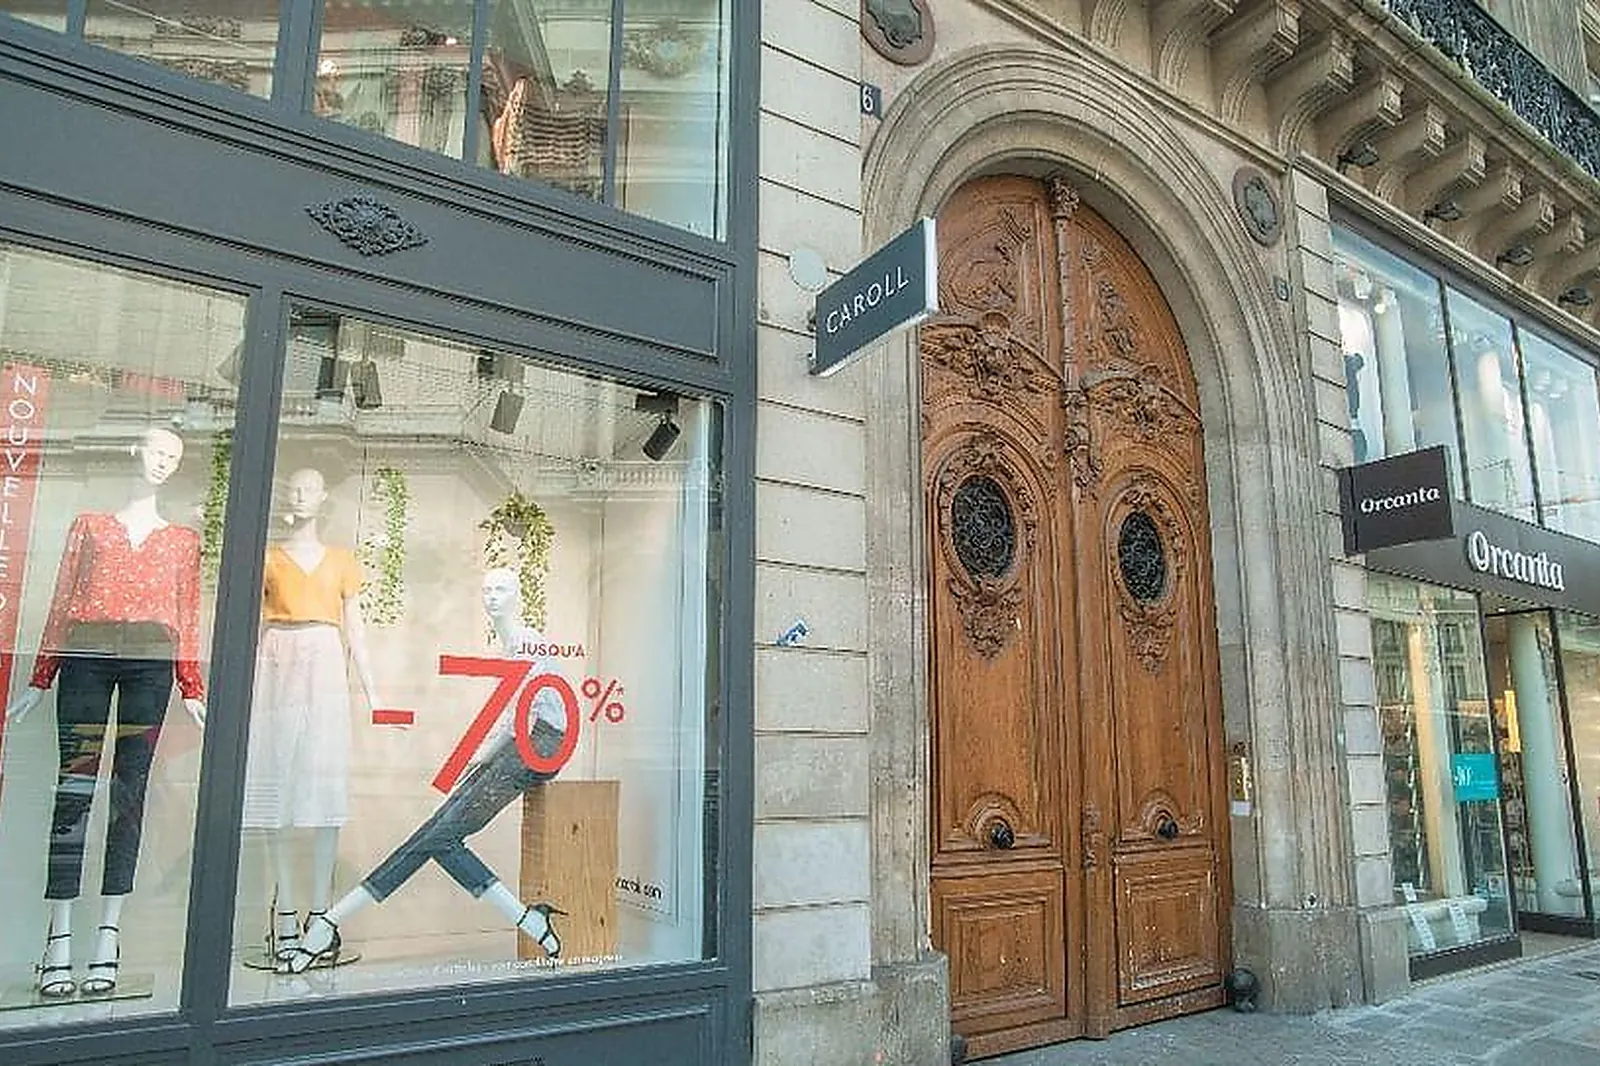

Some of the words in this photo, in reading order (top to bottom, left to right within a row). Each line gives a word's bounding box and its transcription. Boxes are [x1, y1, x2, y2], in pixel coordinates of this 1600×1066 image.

[862, 85, 874, 112] 6
[826, 266, 909, 333] CAROLL
[1360, 486, 1441, 513] Orcanta
[1468, 530, 1566, 592] Orcanta
